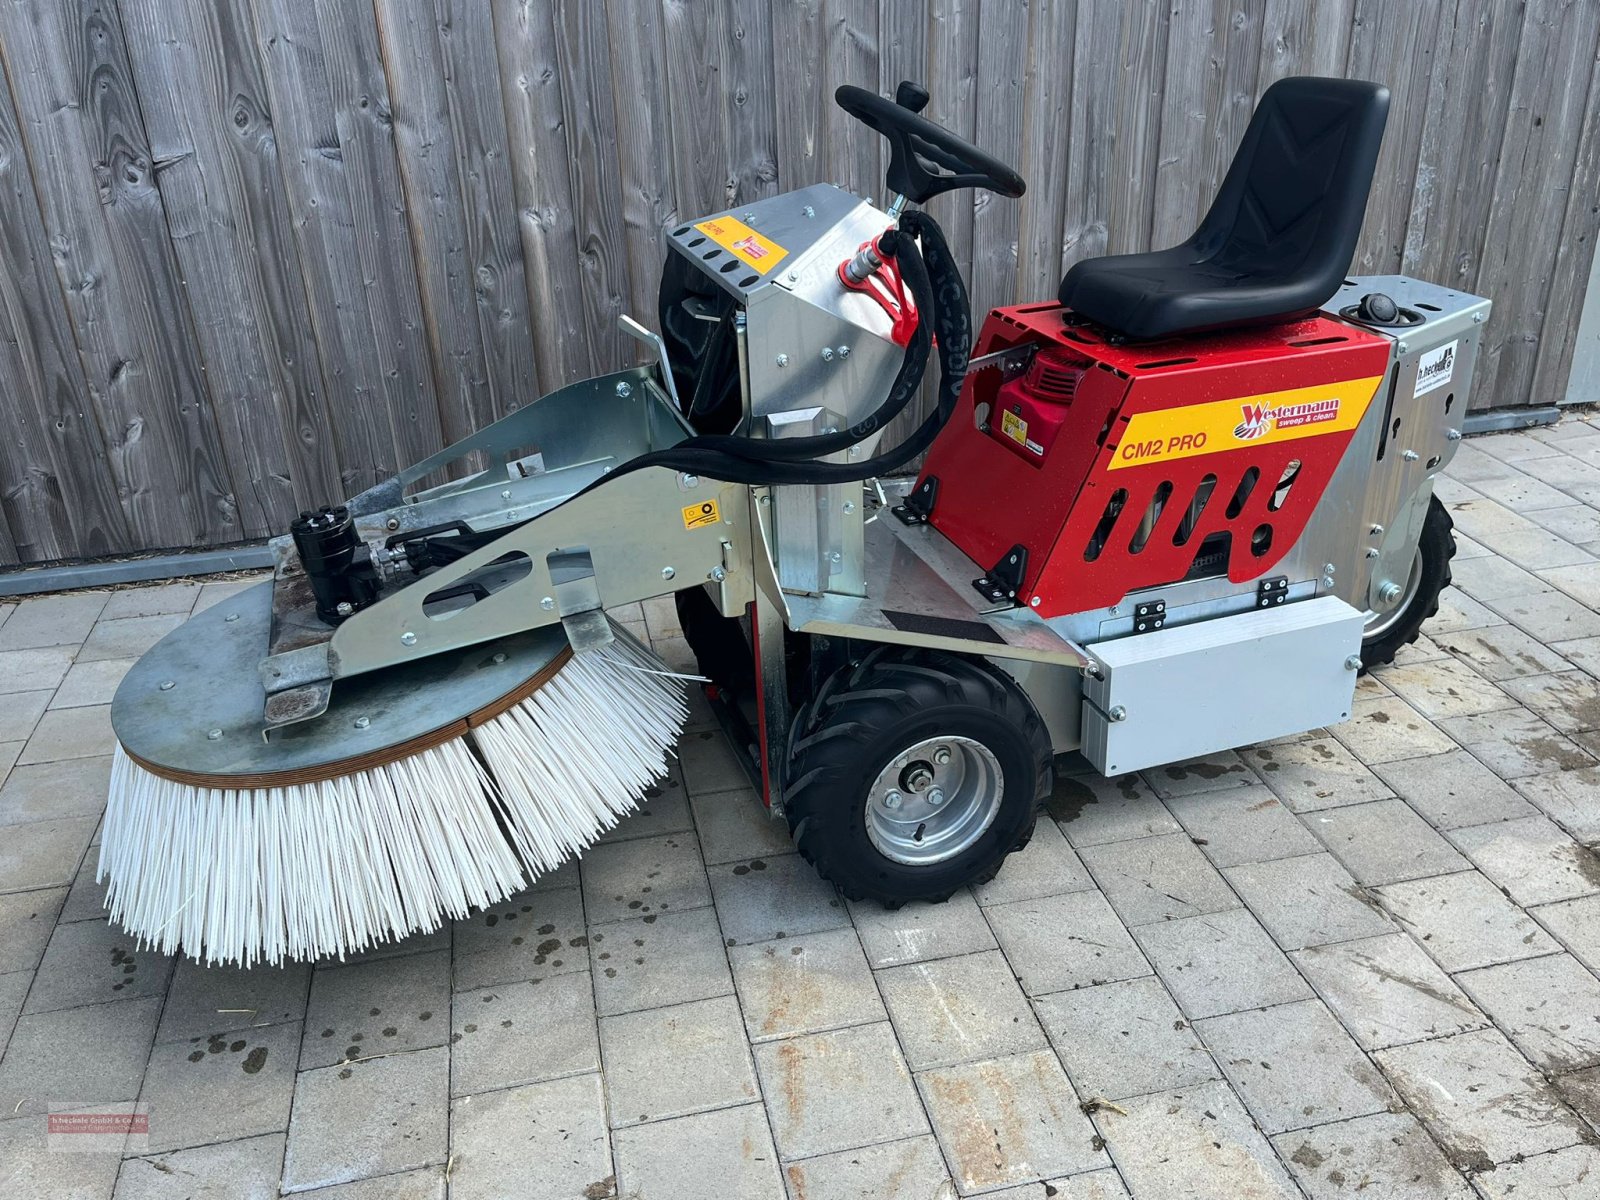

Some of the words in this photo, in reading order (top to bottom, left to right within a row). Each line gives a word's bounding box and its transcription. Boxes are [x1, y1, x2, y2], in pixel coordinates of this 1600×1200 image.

[1241, 399, 1340, 428] Westermann
[1278, 418, 1304, 428] sweep
[1305, 414, 1312, 423] &
[1312, 411, 1336, 422] clean.
[1121, 439, 1164, 461] CM2
[1166, 432, 1207, 454] PRO
